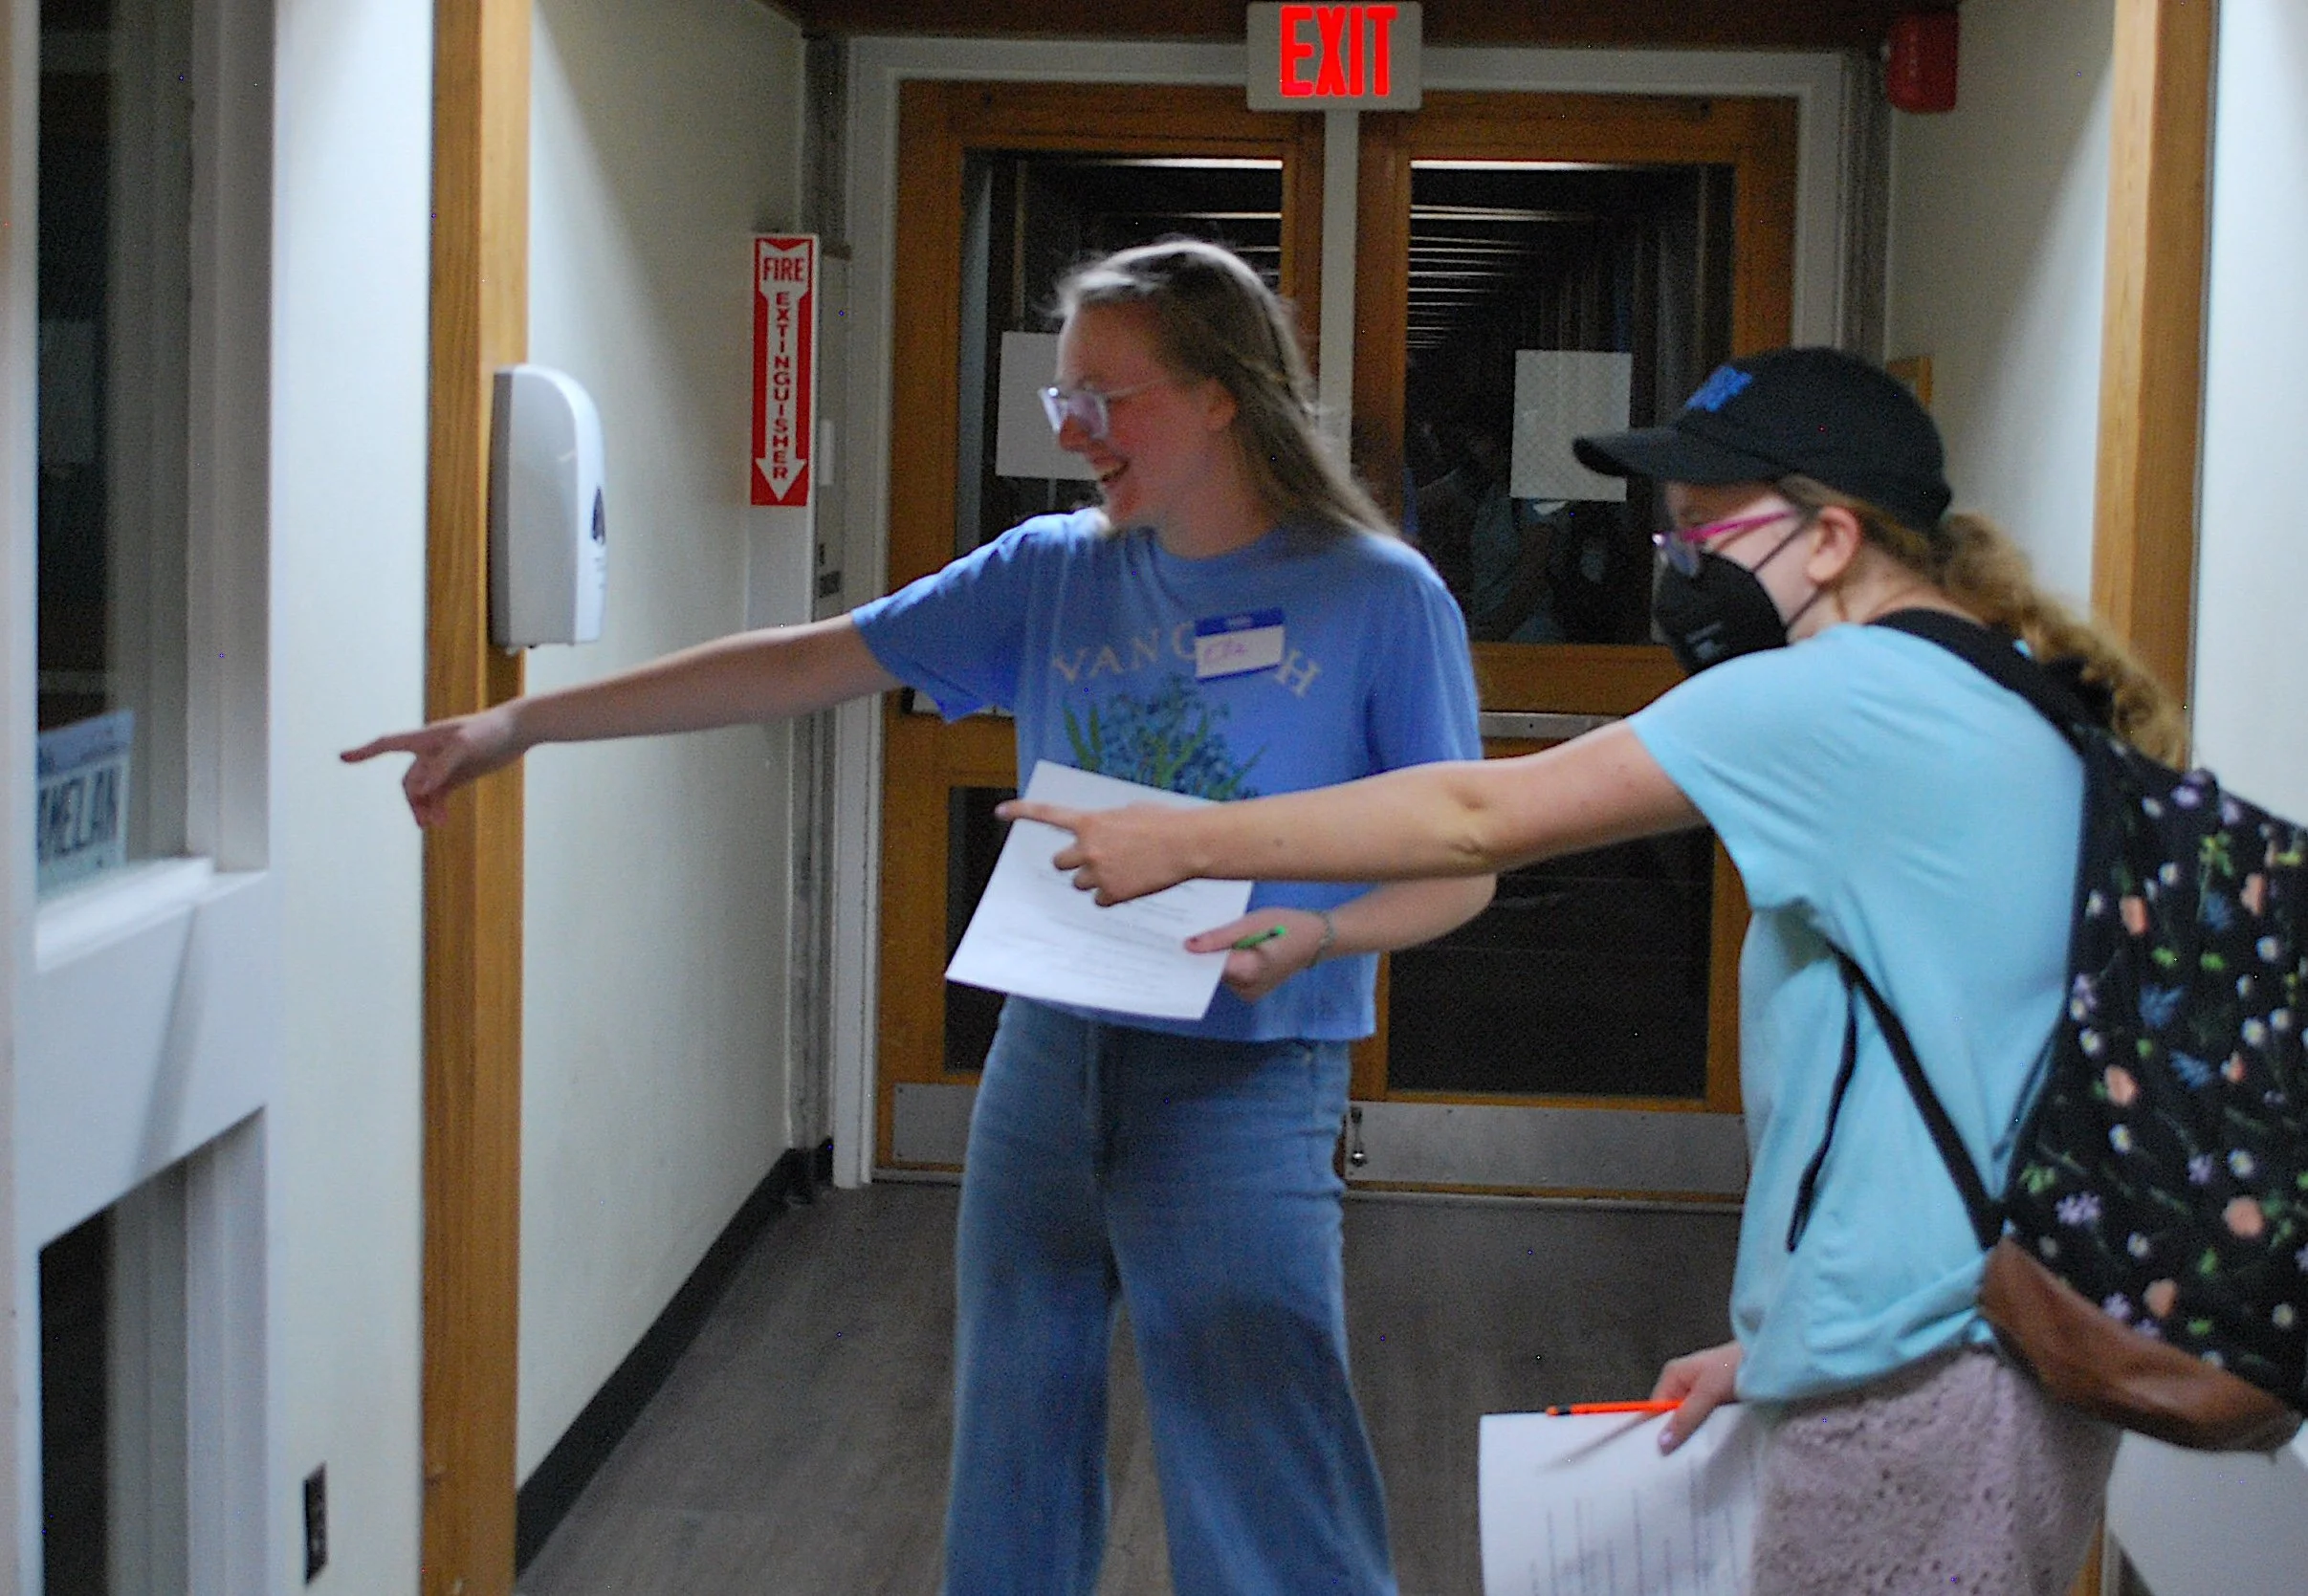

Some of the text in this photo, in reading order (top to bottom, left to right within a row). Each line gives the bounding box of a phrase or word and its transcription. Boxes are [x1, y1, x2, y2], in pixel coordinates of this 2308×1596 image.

[1280, 5, 1398, 98] EXIT
[763, 256, 804, 282] FIRE
[773, 291, 790, 480] EXTINGUISHER
